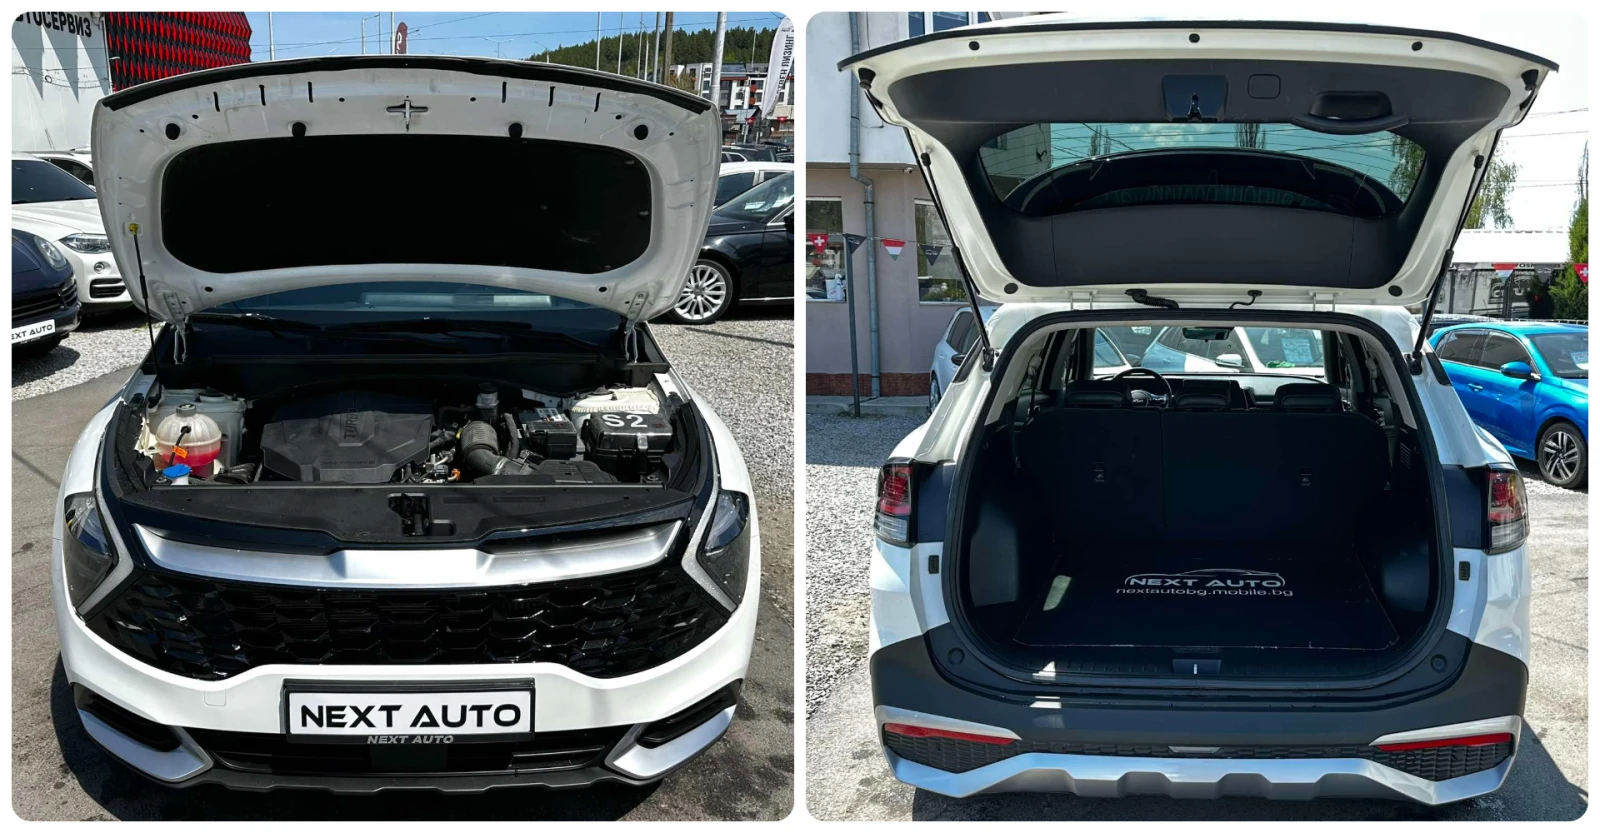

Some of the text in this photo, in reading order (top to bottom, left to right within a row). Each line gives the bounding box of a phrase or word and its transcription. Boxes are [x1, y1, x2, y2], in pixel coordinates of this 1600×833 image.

[29, 324, 53, 336] AUTO
[602, 414, 648, 428] S2
[1129, 578, 1281, 588] NEXT AUTO
[1116, 588, 1293, 597] nextautobg.mobile.bg
[301, 703, 521, 728] NEXT AUTO
[366, 735, 454, 744] NEXT AUTO
